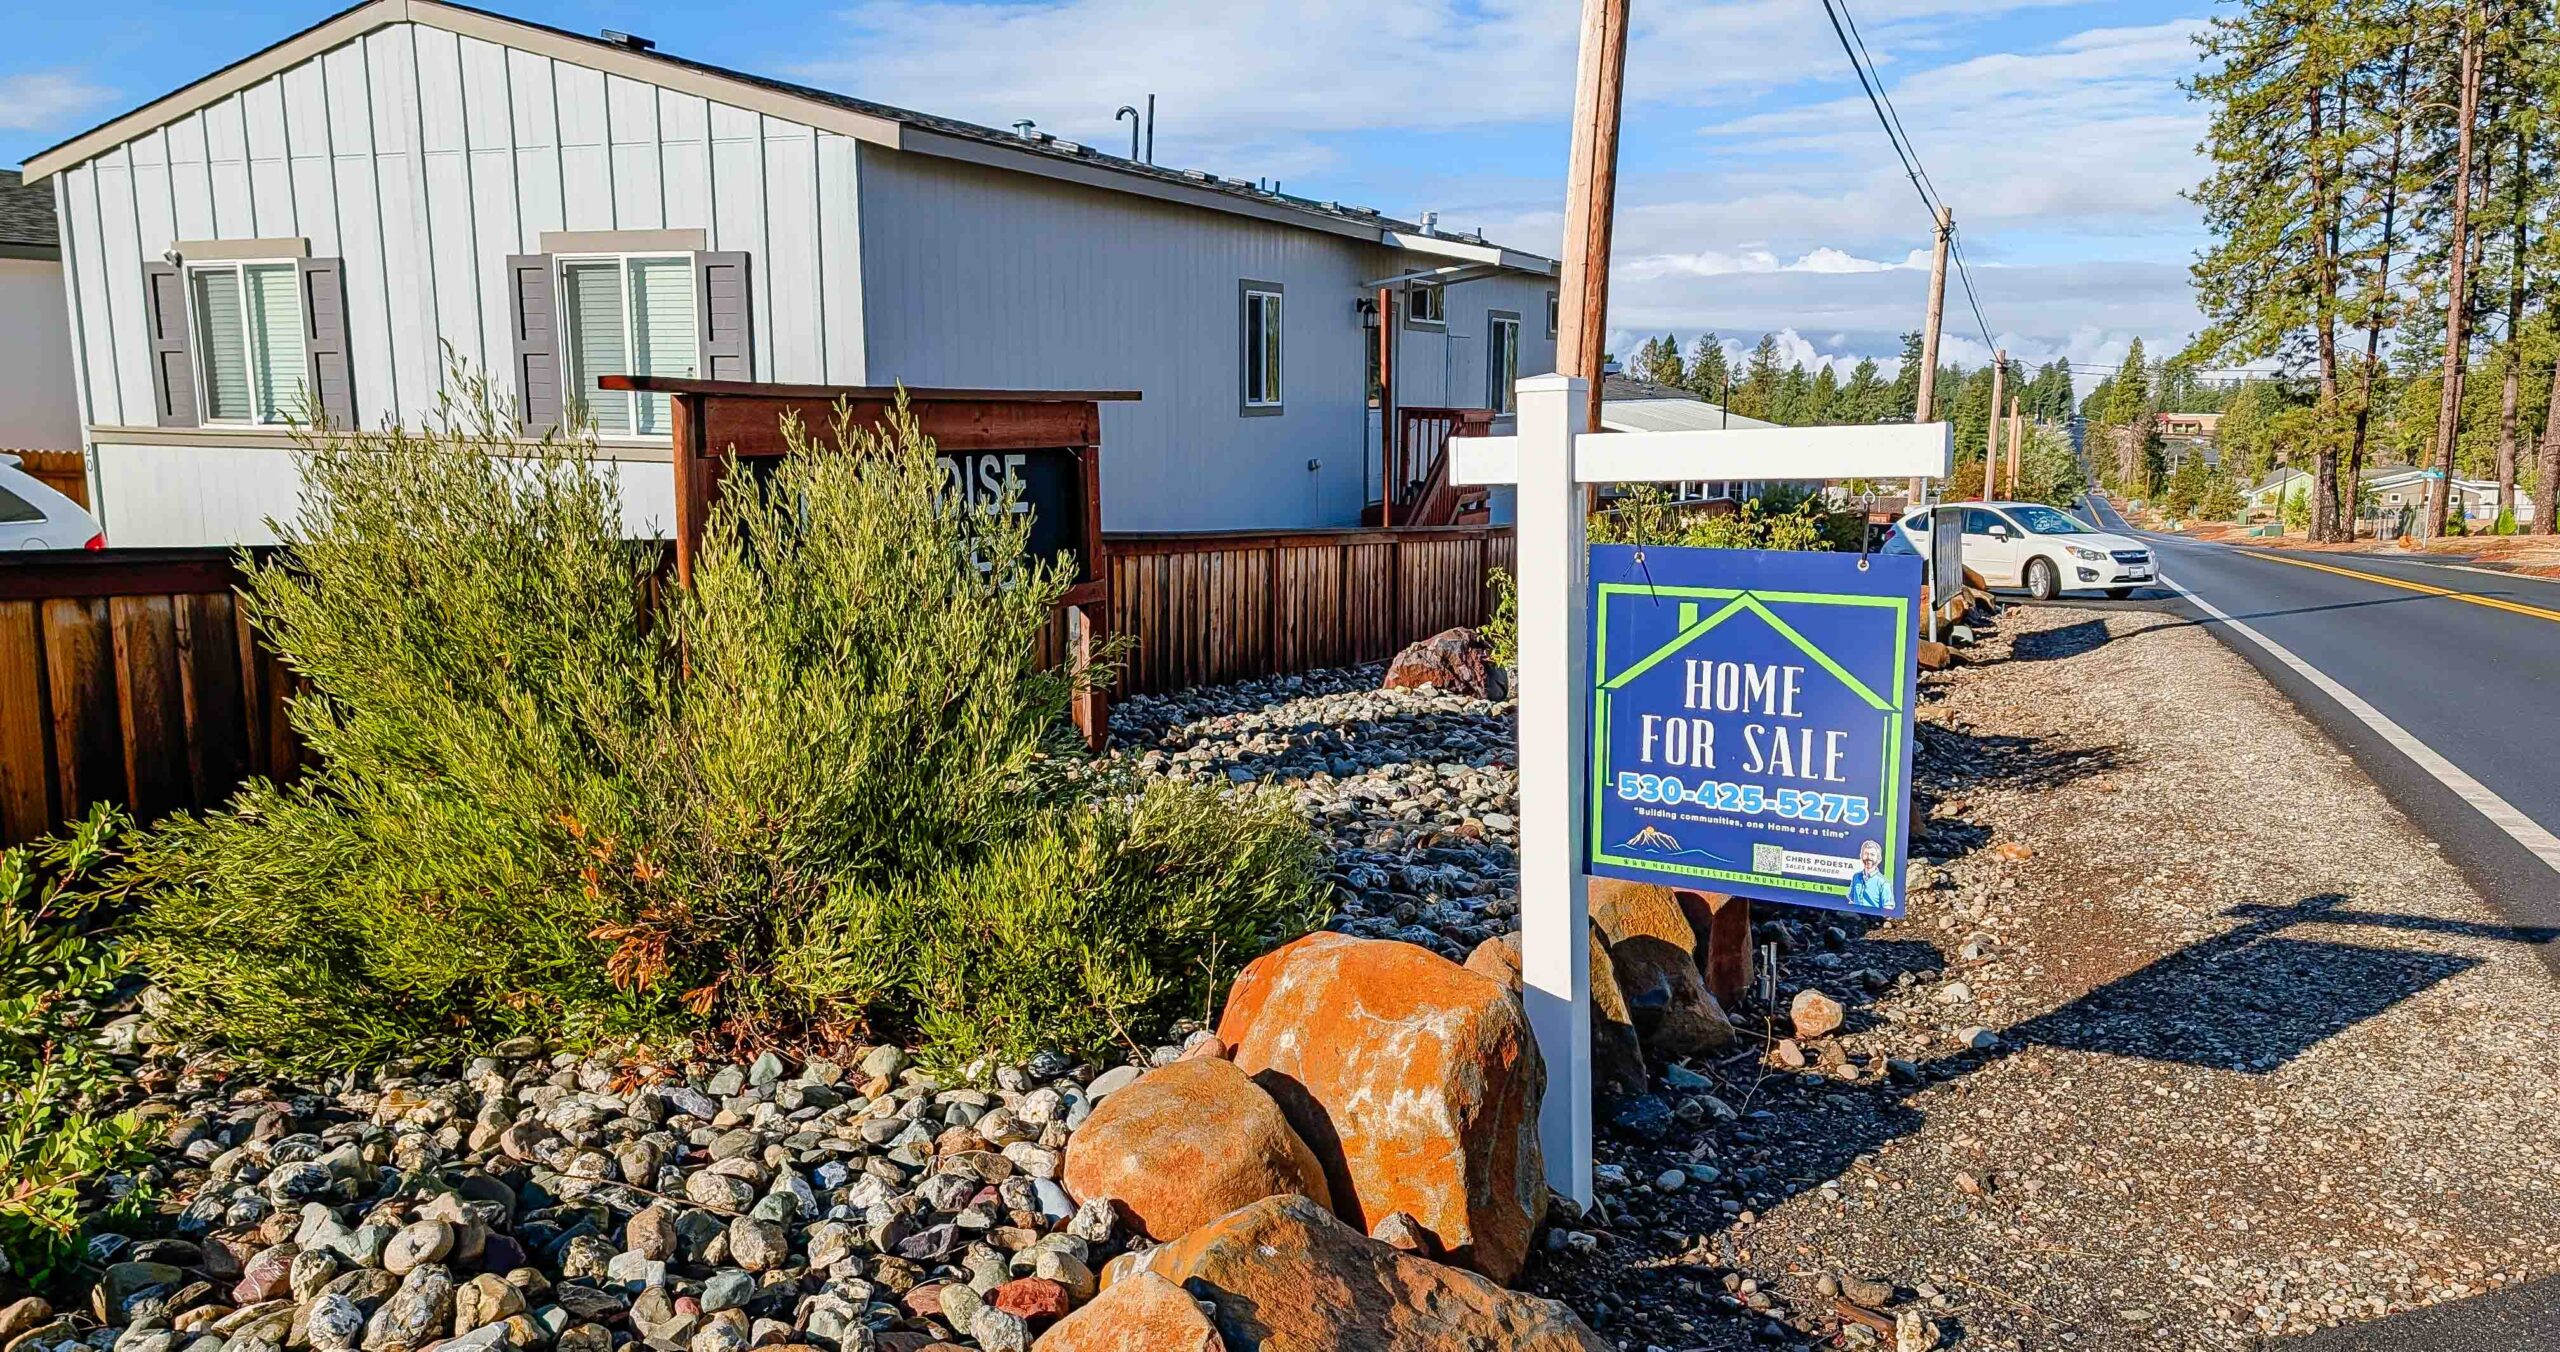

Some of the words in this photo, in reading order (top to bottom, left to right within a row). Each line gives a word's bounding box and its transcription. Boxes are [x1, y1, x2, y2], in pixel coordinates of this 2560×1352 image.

[85, 443, 94, 473] 20
[1684, 658, 1805, 718] HOME
[1640, 713, 1717, 769] FOR
[1742, 723, 1848, 783] SALE
[1617, 771, 1870, 826] 530-425-5275
[1634, 806, 1677, 821] "Building
[1680, 813, 1743, 828] communities,
[1746, 821, 1764, 830] one
[1767, 822, 1796, 833] Home
[1799, 826, 1809, 835] at
[1812, 828, 1819, 836] a
[1822, 828, 1850, 839] time"
[1785, 855, 1812, 865] CHRIS
[1814, 859, 1854, 870] PODESTA
[1785, 863, 1805, 871] SALES
[1806, 866, 1840, 875] MANAGER
